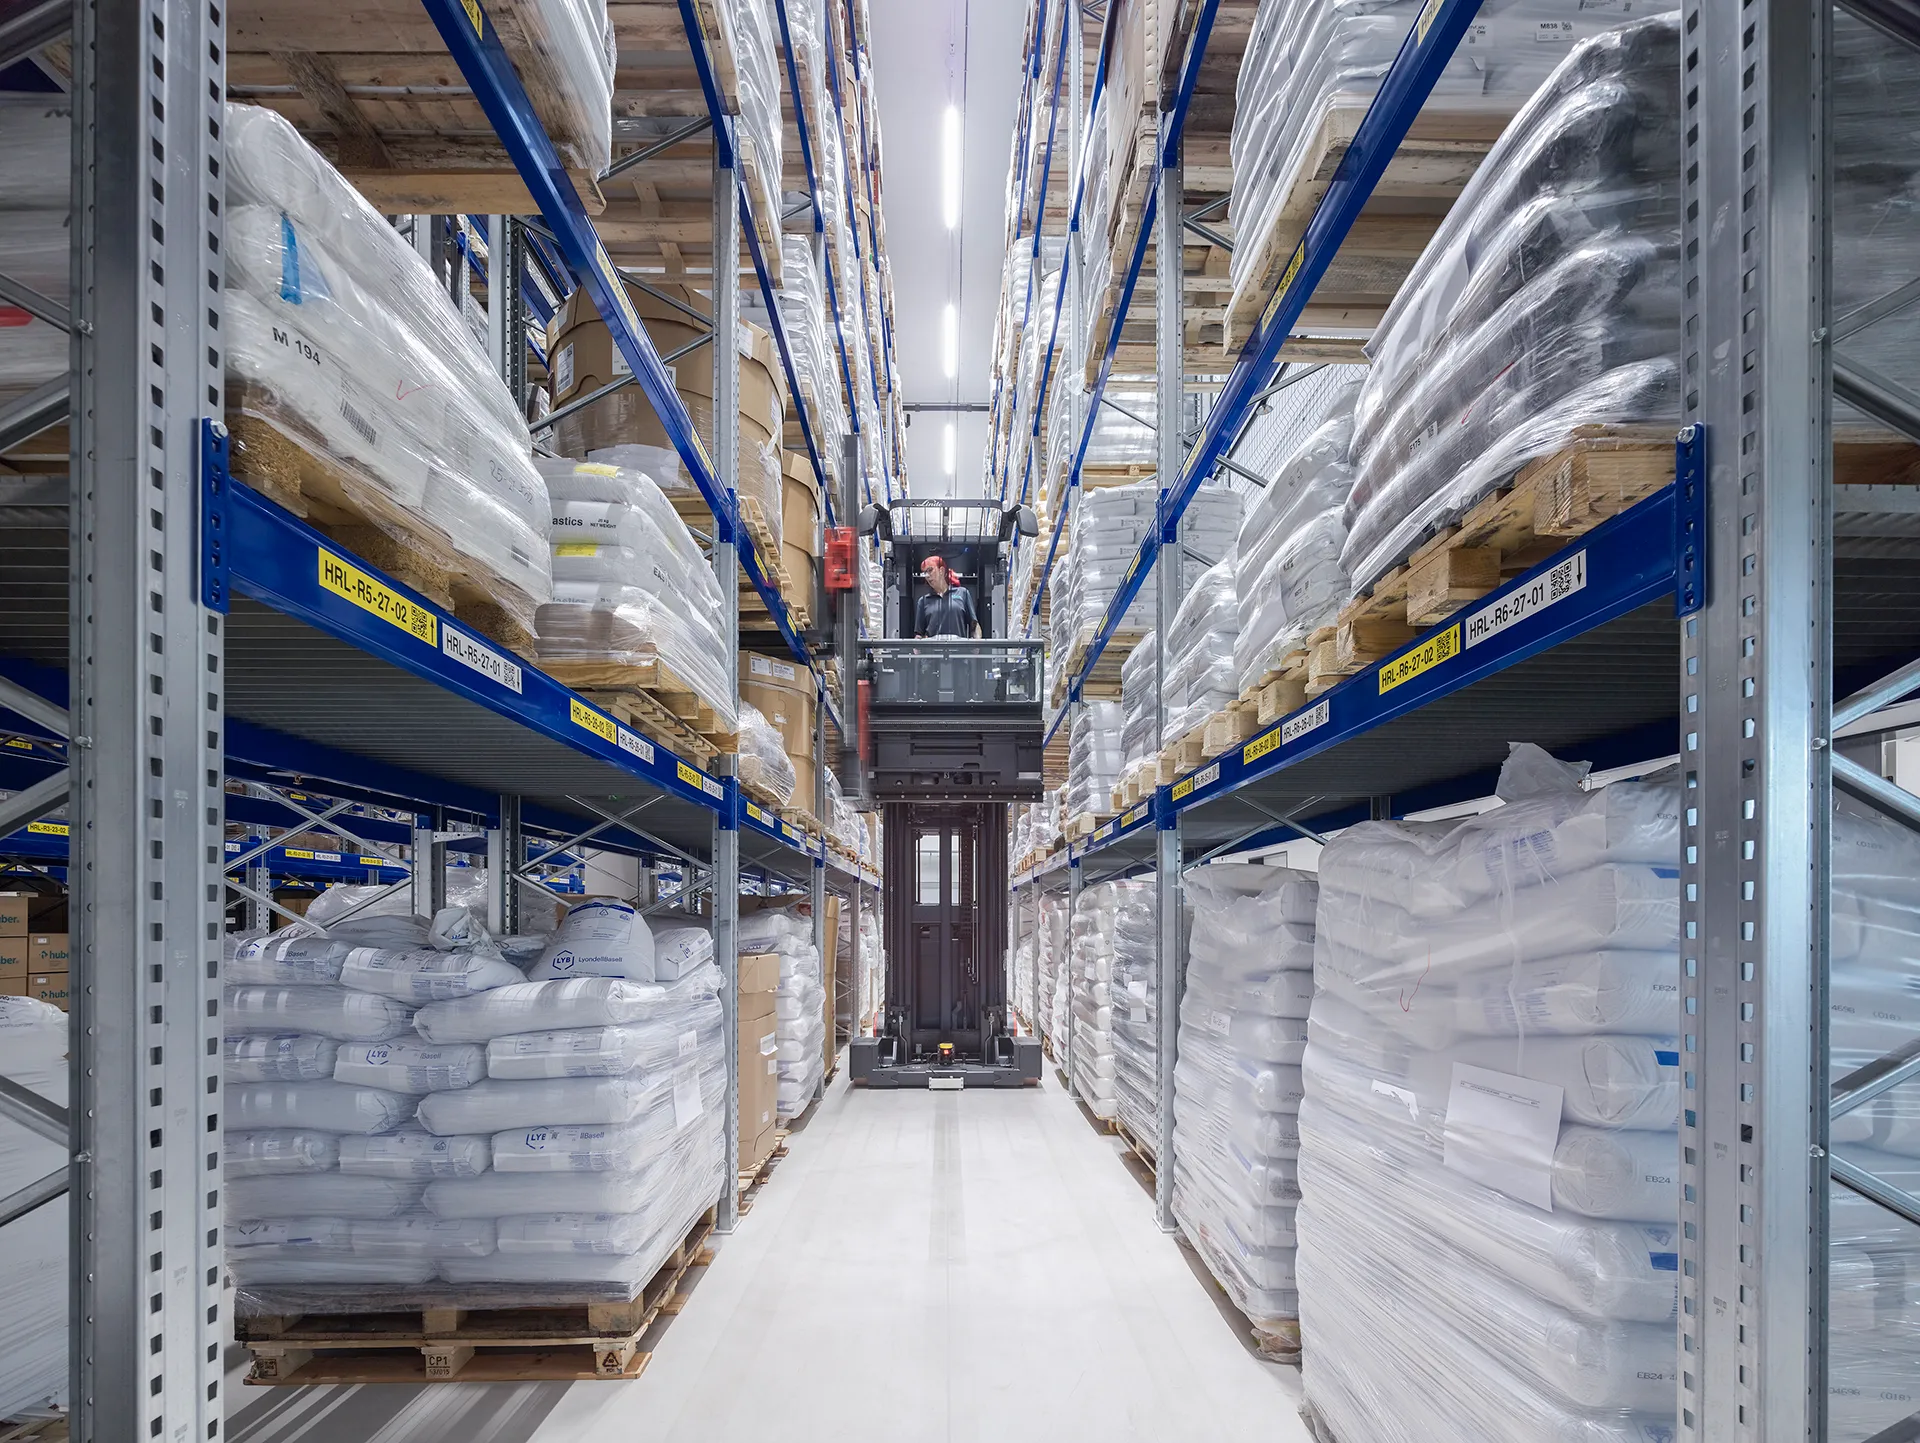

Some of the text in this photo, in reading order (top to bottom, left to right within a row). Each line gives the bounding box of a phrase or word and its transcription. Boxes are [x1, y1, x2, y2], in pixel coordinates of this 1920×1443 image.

[272, 326, 321, 366] M 194
[551, 516, 583, 527] astics
[324, 559, 408, 624] HRL-R5-27-02
[1470, 582, 1544, 640] HRL-R6-27-01
[446, 632, 501, 677] HRL-R5-27-01
[1381, 646, 1434, 688] HRL-R6-27-02
[572, 704, 605, 734] HRL-R5-26-02
[556, 954, 623, 964] LYB LyondellBasell
[1653, 984, 1677, 992] EB24
[371, 1050, 388, 1059] LYB
[1645, 1175, 1671, 1184] EB24
[429, 1356, 448, 1366] CP1
[1637, 1371, 1663, 1380] EB24
